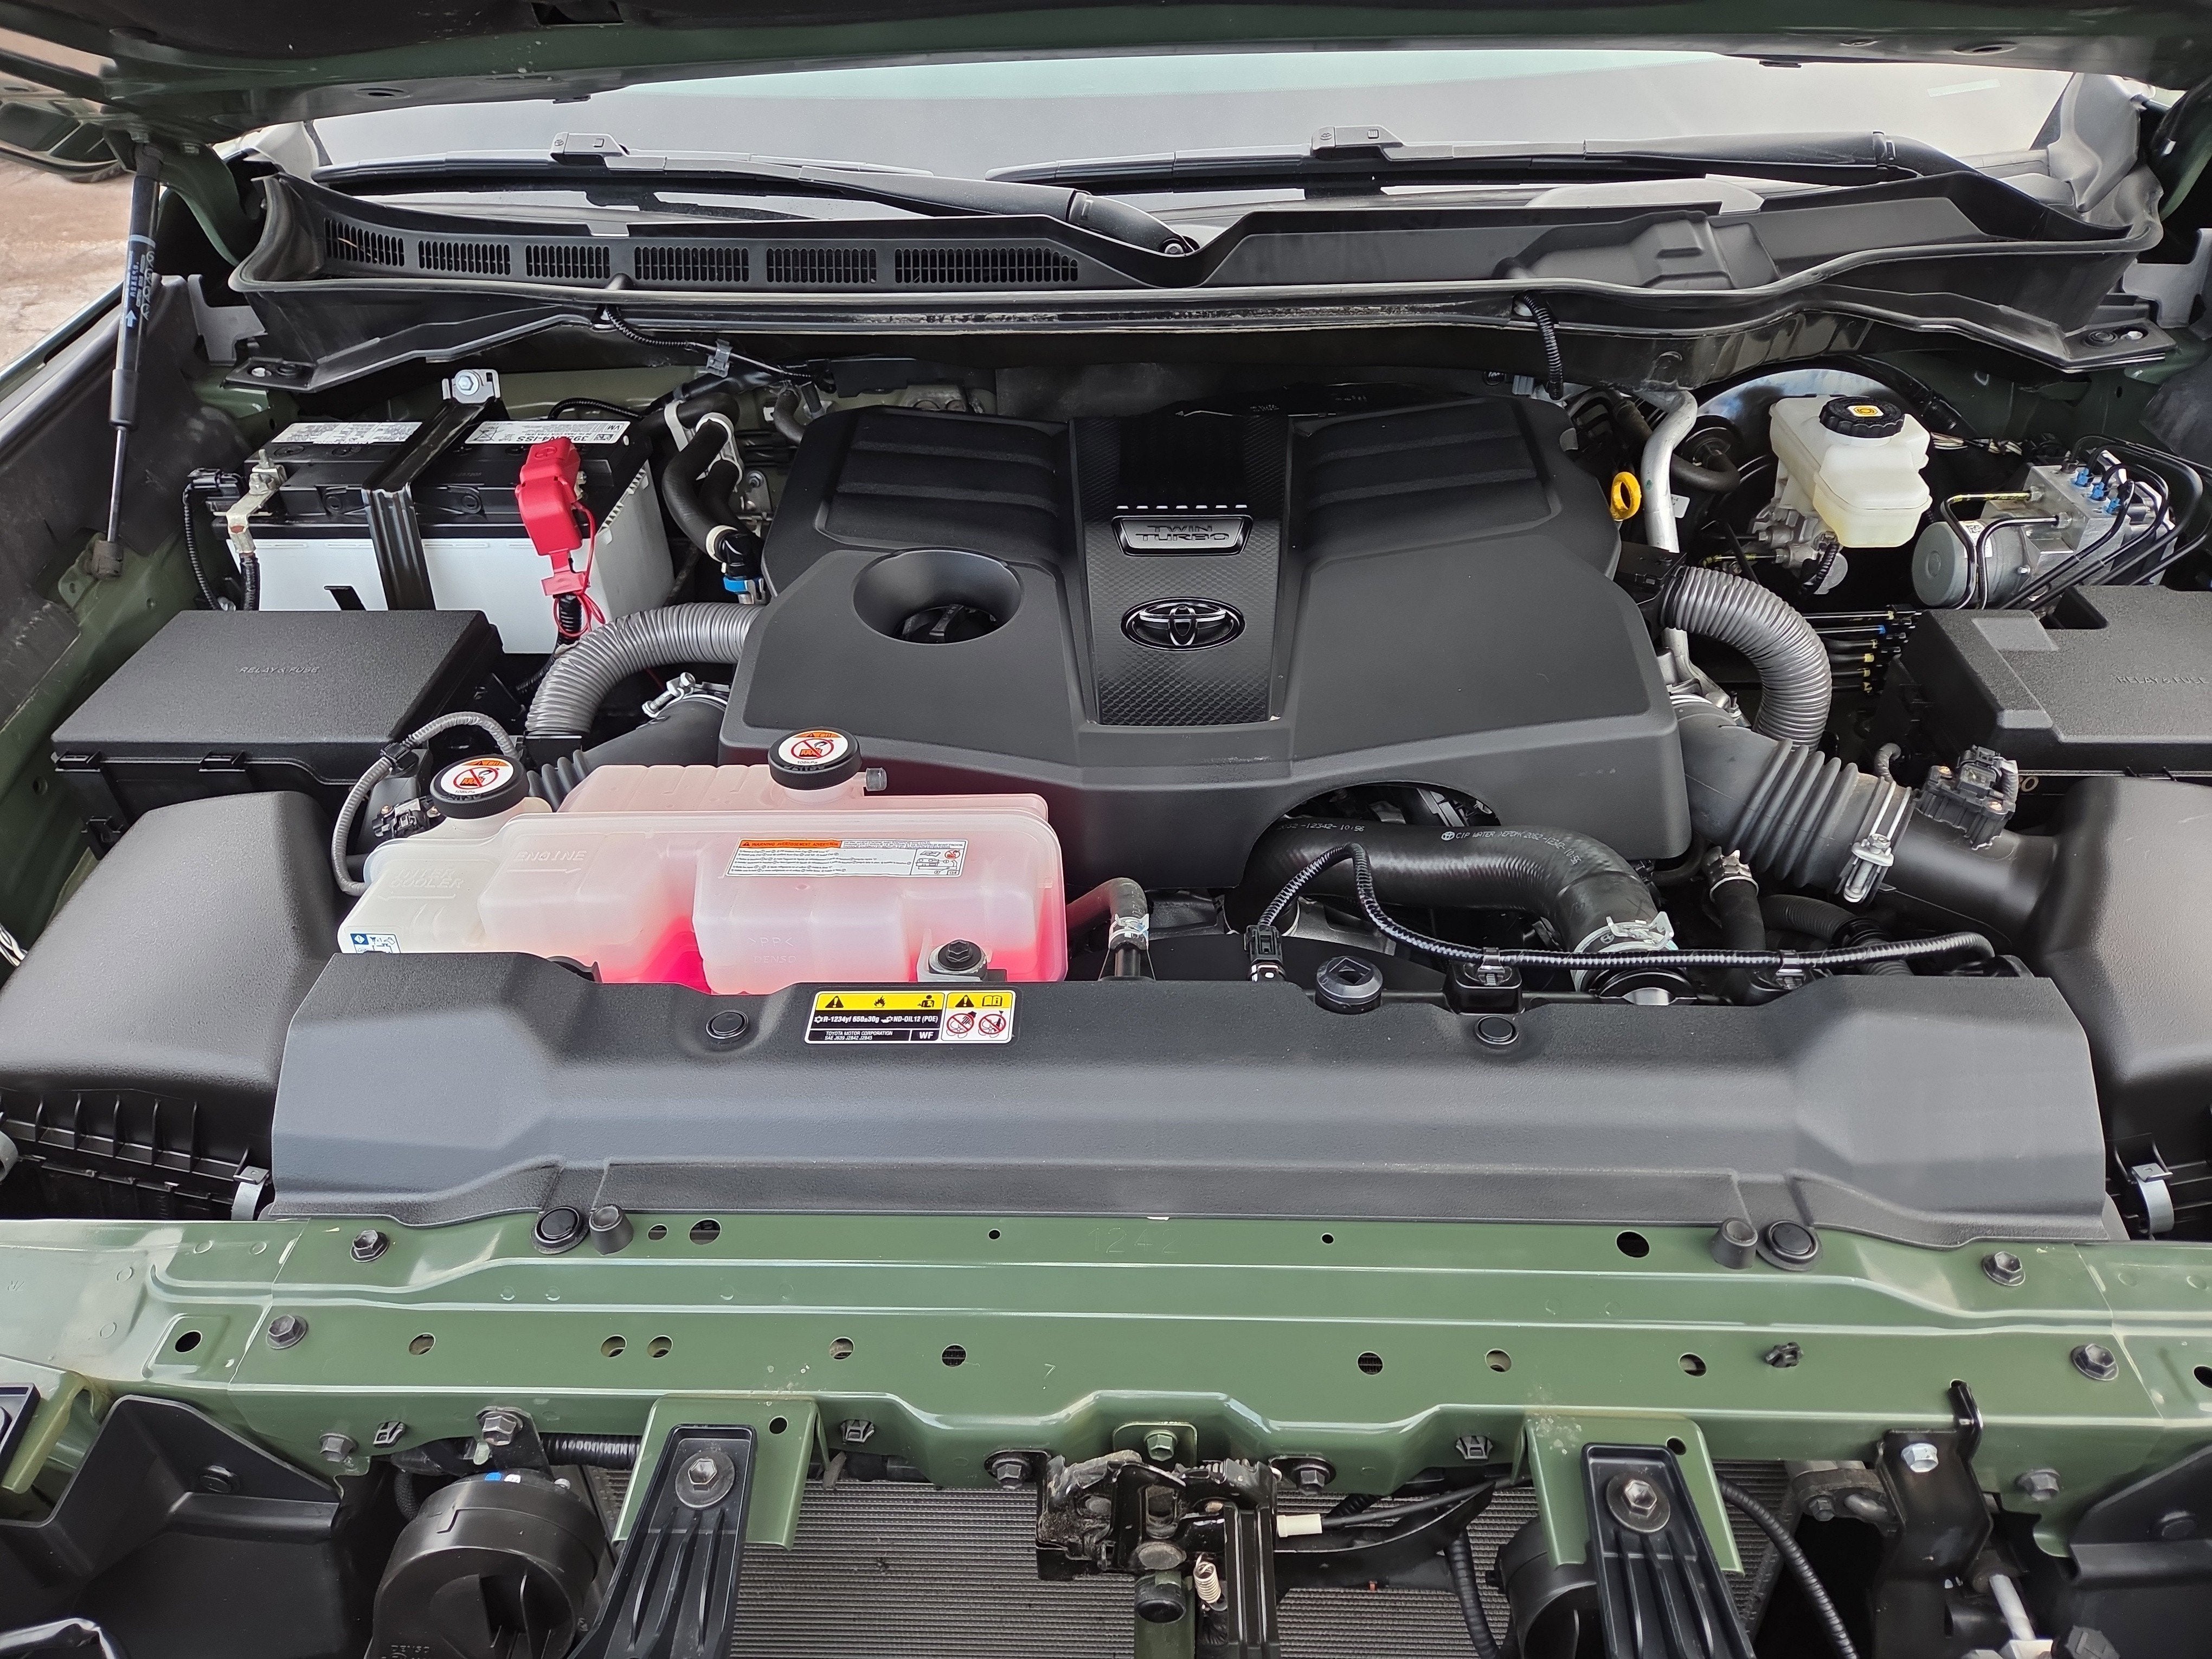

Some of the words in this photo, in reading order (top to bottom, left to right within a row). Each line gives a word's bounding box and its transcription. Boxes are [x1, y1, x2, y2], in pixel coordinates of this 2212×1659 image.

[1135, 532, 1230, 542] TURBO
[513, 850, 588, 862] ENGINE
[390, 878, 465, 889] COOLER
[754, 955, 797, 963] DENSO
[823, 1015, 852, 1024] R-1234yf
[922, 1015, 938, 1024] (POE)
[919, 1031, 934, 1039] WF
